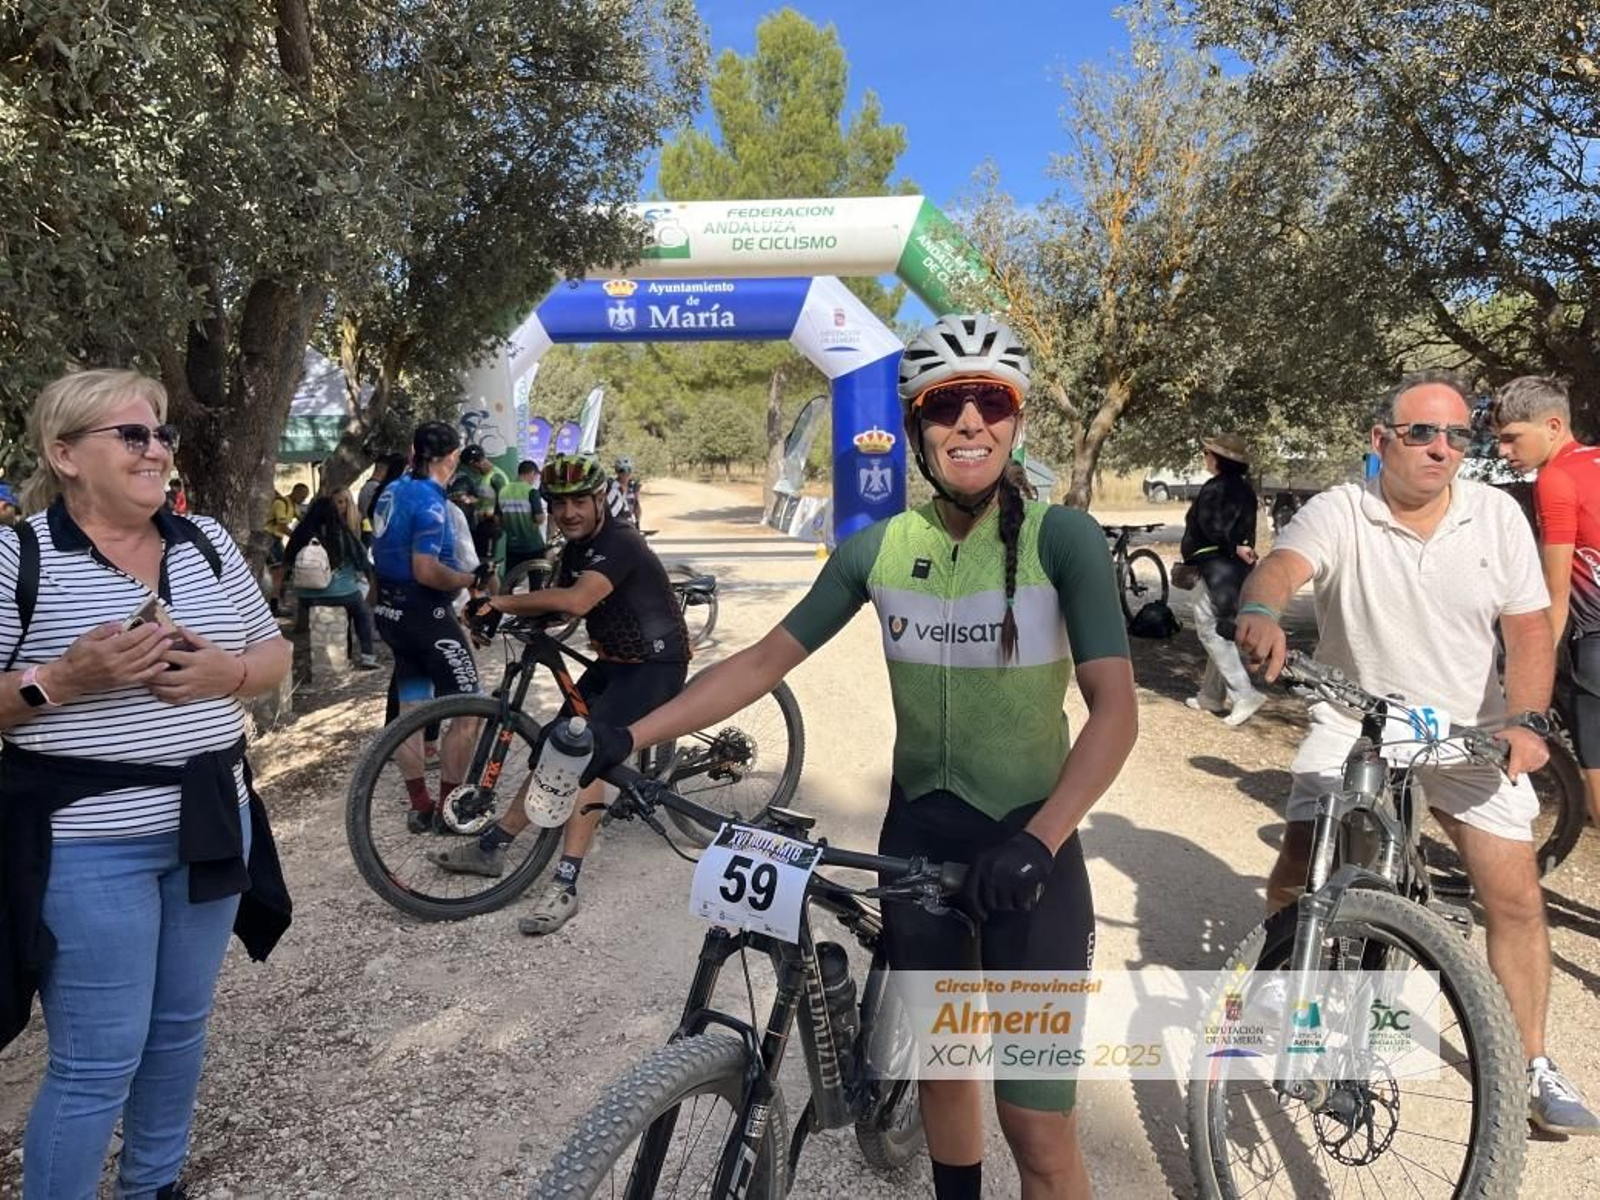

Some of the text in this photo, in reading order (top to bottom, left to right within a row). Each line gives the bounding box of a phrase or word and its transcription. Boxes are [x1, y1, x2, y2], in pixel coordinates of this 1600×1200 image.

[703, 220, 797, 234] ANDALUZA
[732, 235, 837, 251] DE CICLISMO
[648, 281, 735, 296] Ayuntamiento
[686, 295, 700, 306] de
[647, 303, 736, 329] María
[719, 854, 778, 911] 59
